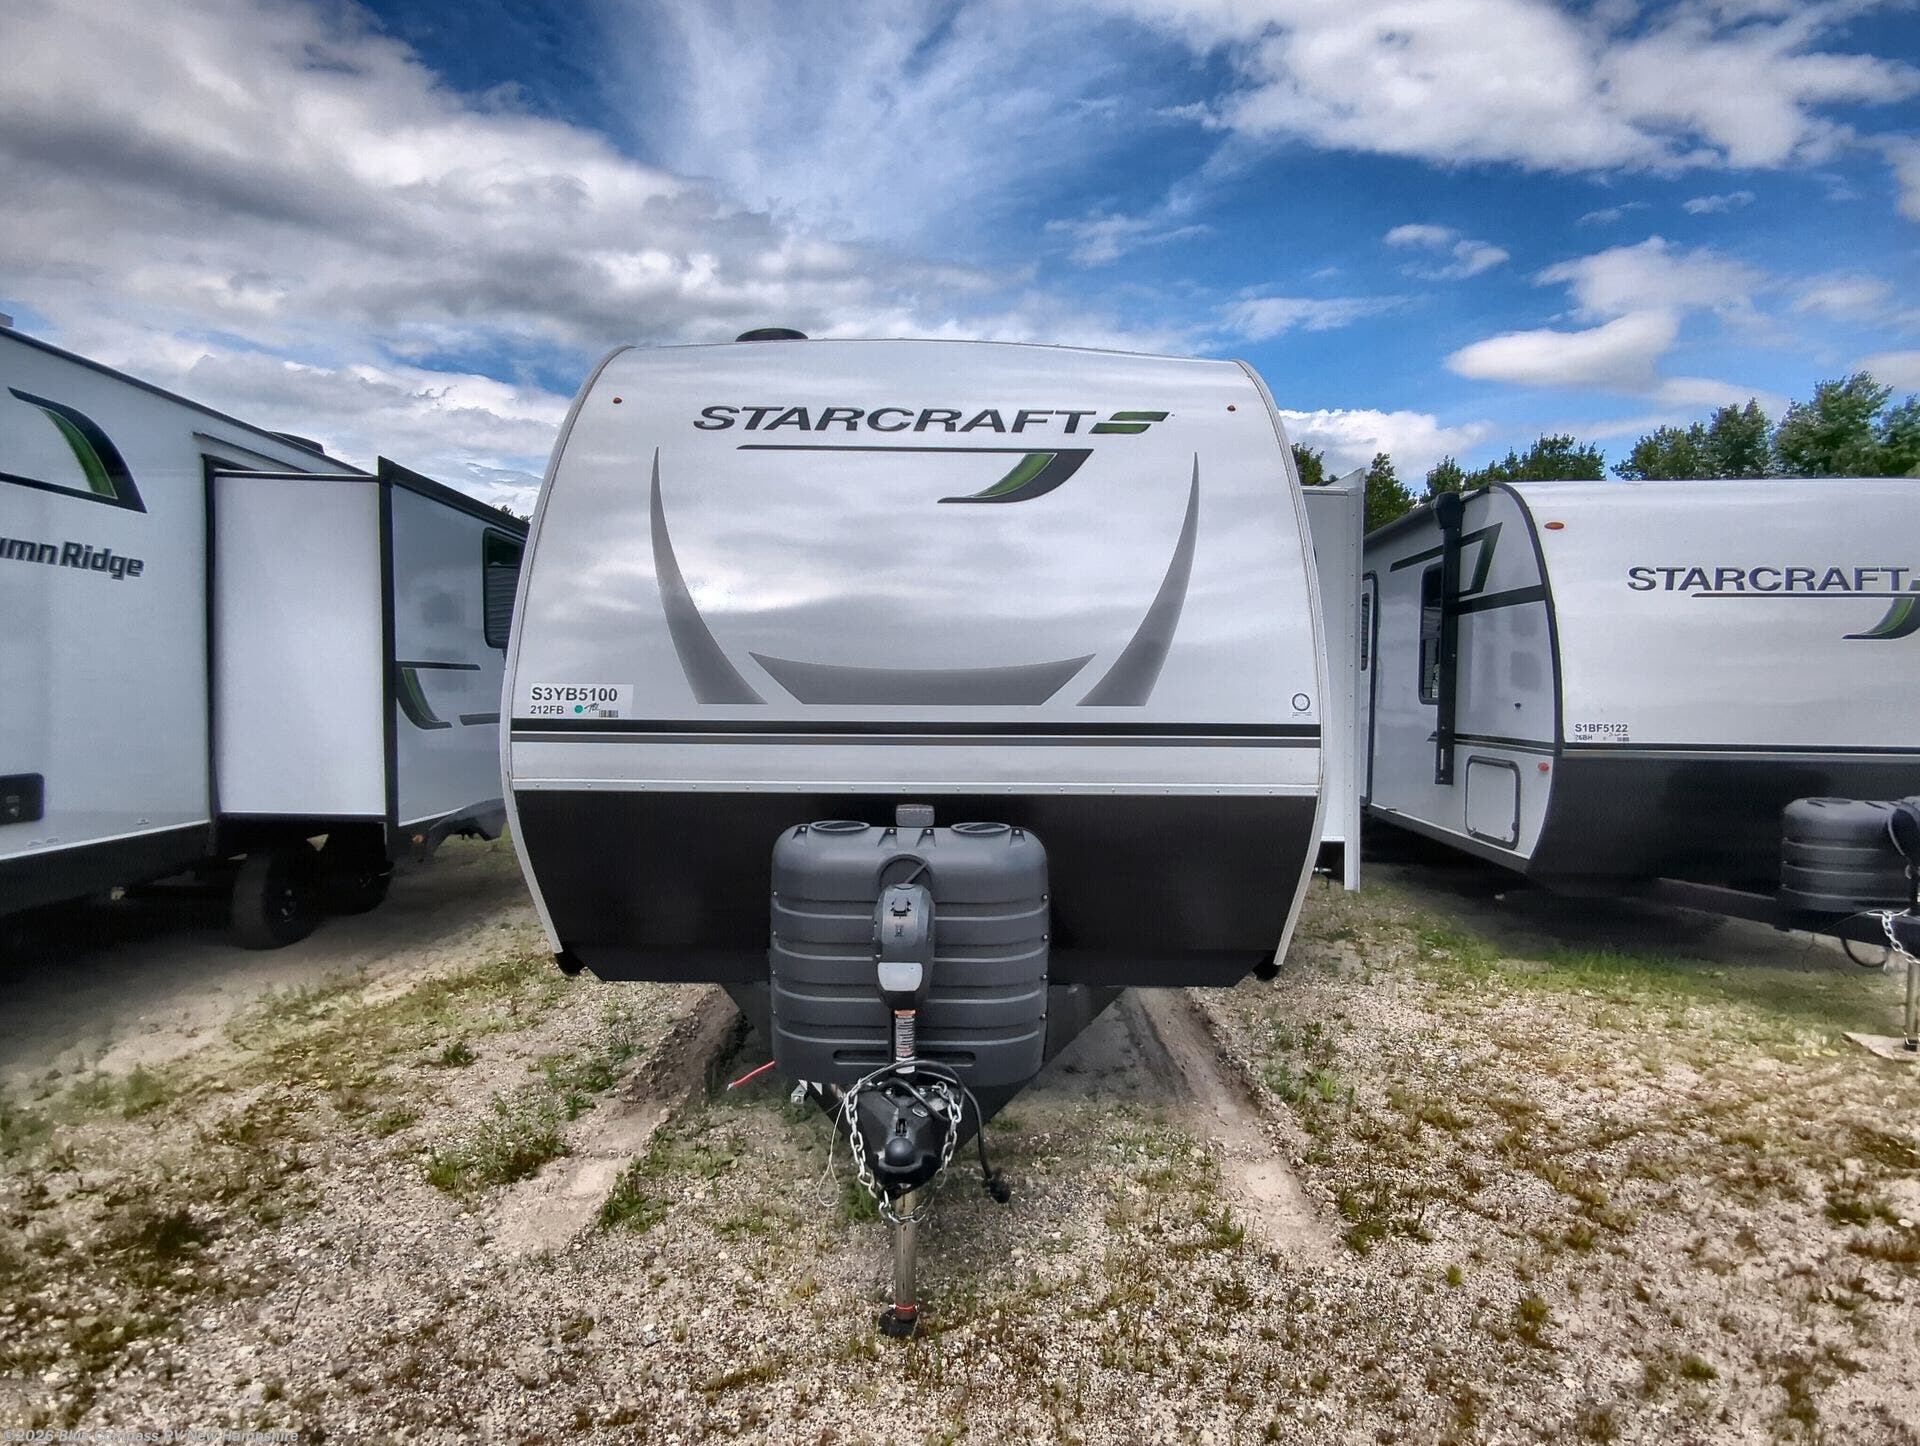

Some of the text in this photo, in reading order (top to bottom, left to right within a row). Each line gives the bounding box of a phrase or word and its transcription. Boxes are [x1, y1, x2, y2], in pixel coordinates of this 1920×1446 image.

[693, 405, 1096, 434] STARCRAFT
[59, 541, 145, 581] Ridge
[1627, 566, 1910, 592] STARCRAFT
[531, 687, 618, 702] S3YB5100
[530, 705, 565, 714] 212FB
[1574, 723, 1628, 733] S1BF5122
